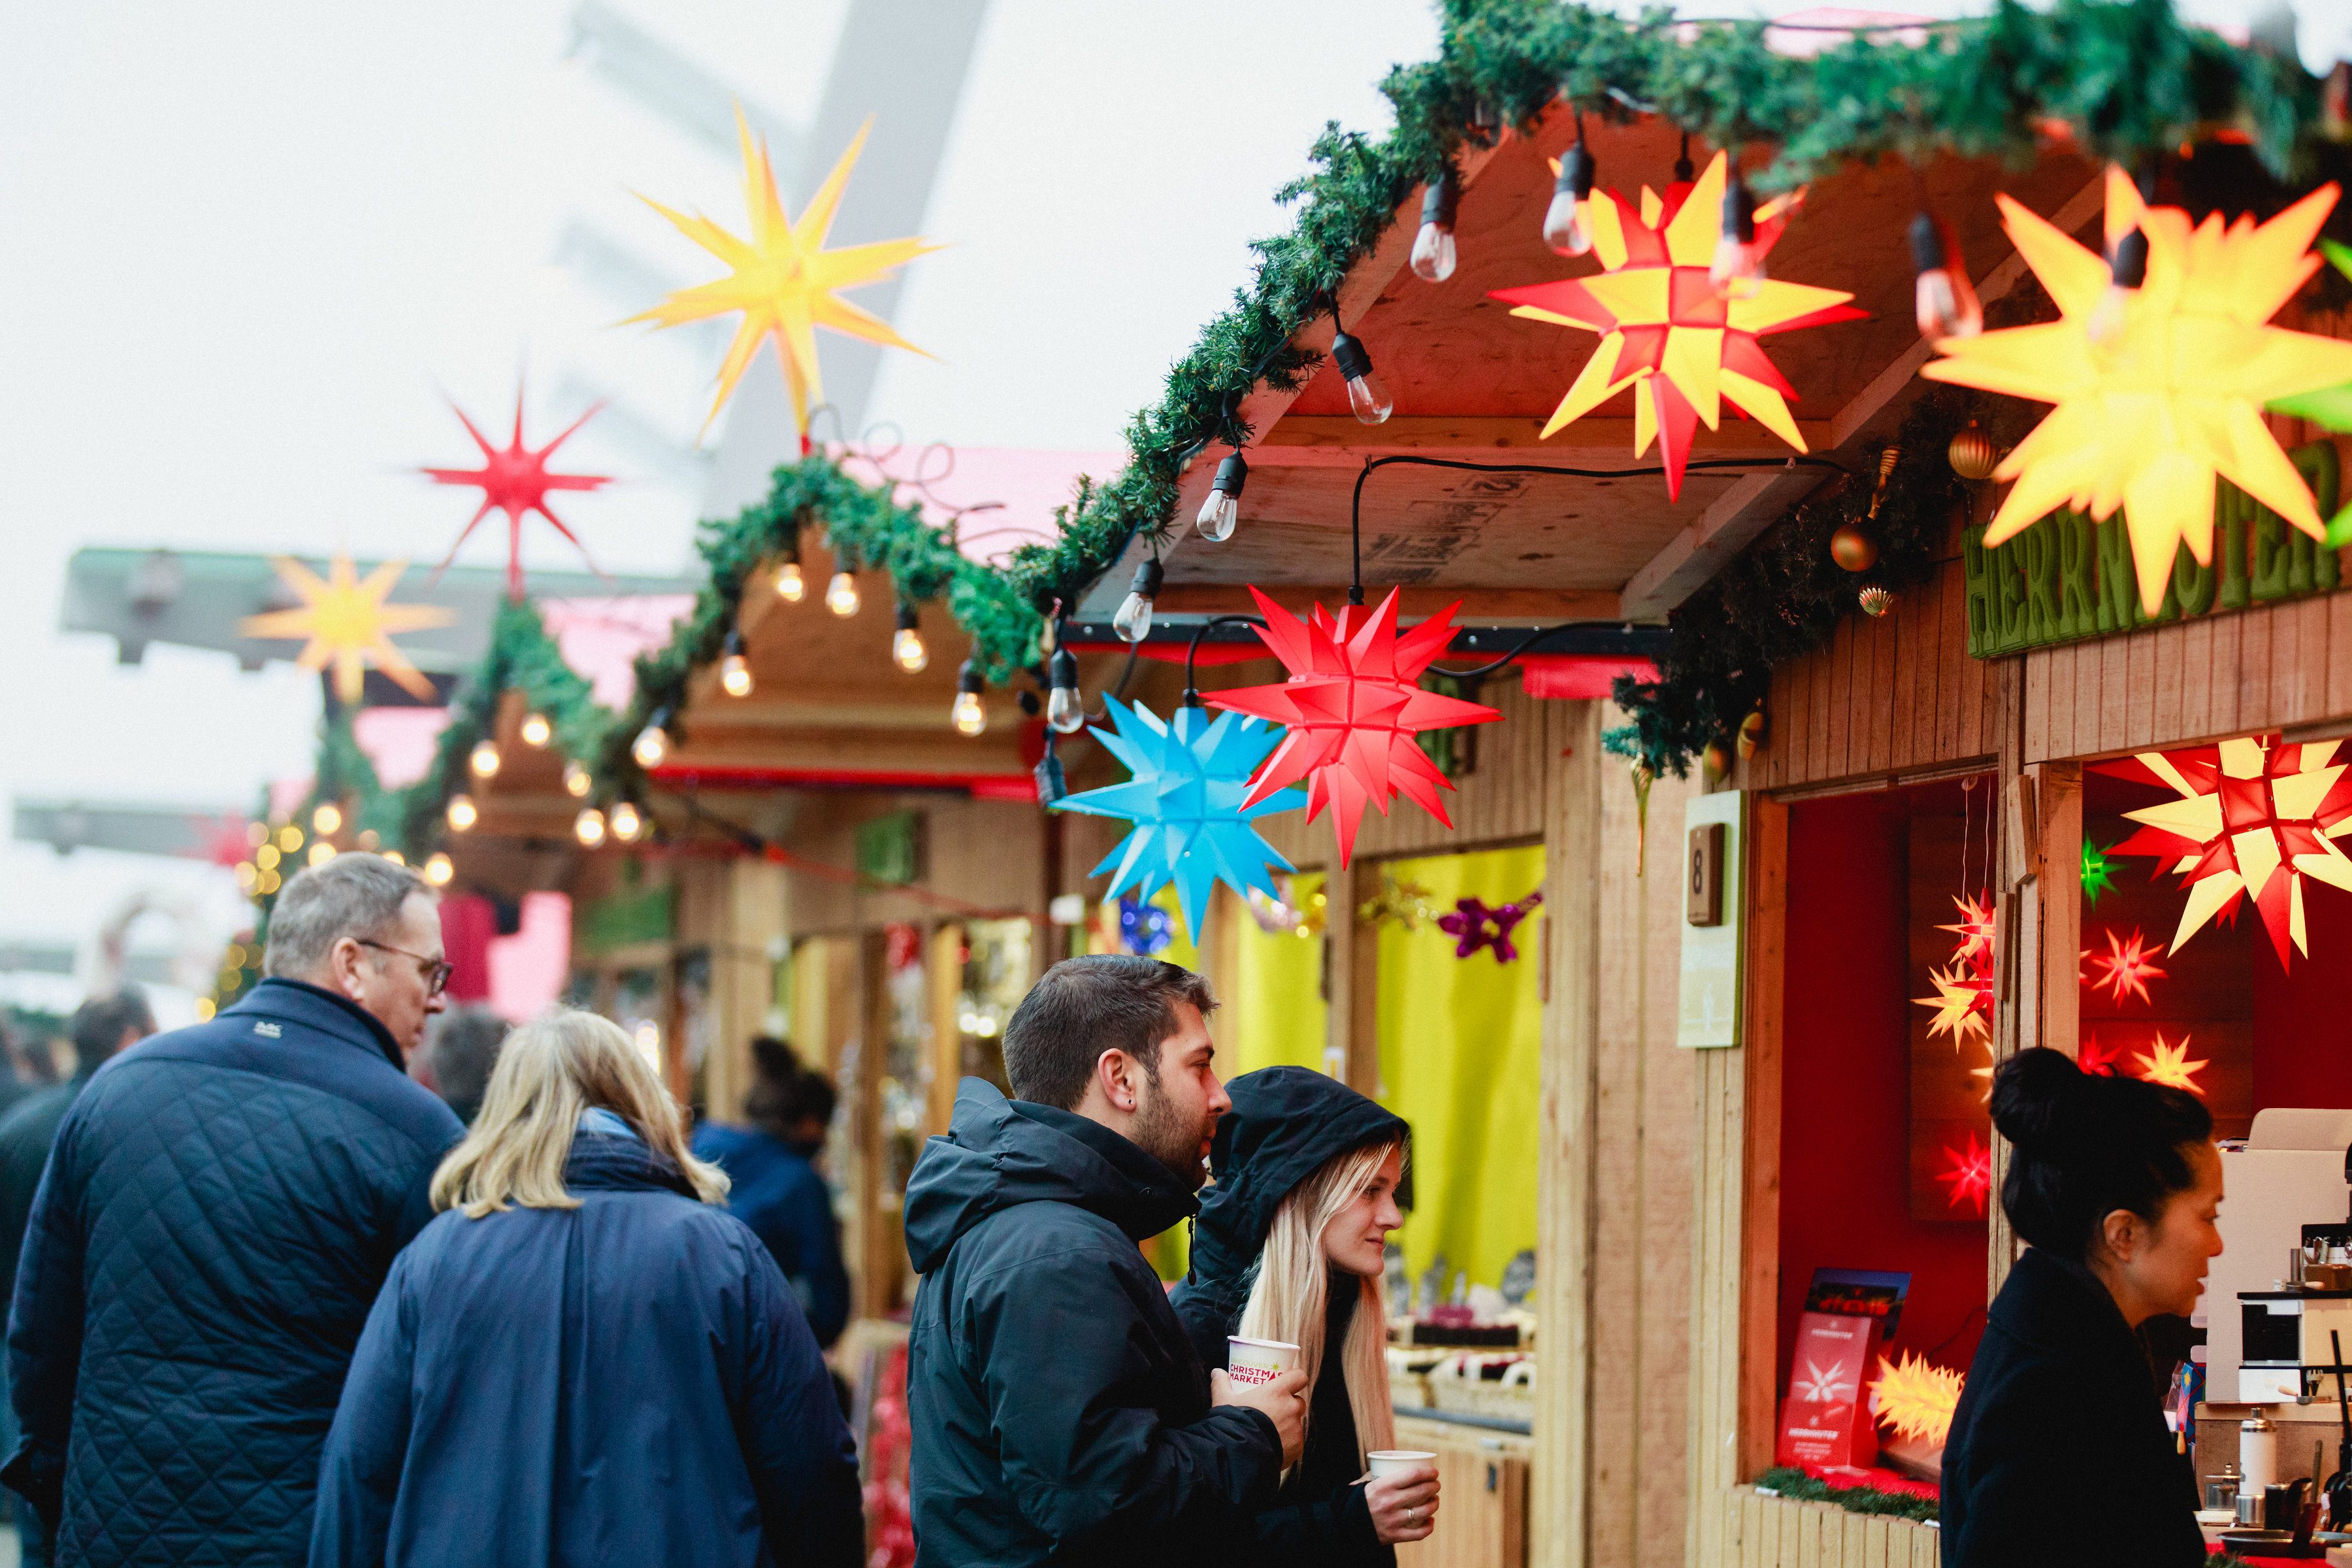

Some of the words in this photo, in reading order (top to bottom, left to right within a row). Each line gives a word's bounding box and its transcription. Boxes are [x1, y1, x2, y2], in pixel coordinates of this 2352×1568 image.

[1962, 440, 2339, 659] HERRNUTER
[1693, 849, 1703, 894] 8
[1230, 1372, 1266, 1385] MARKET
